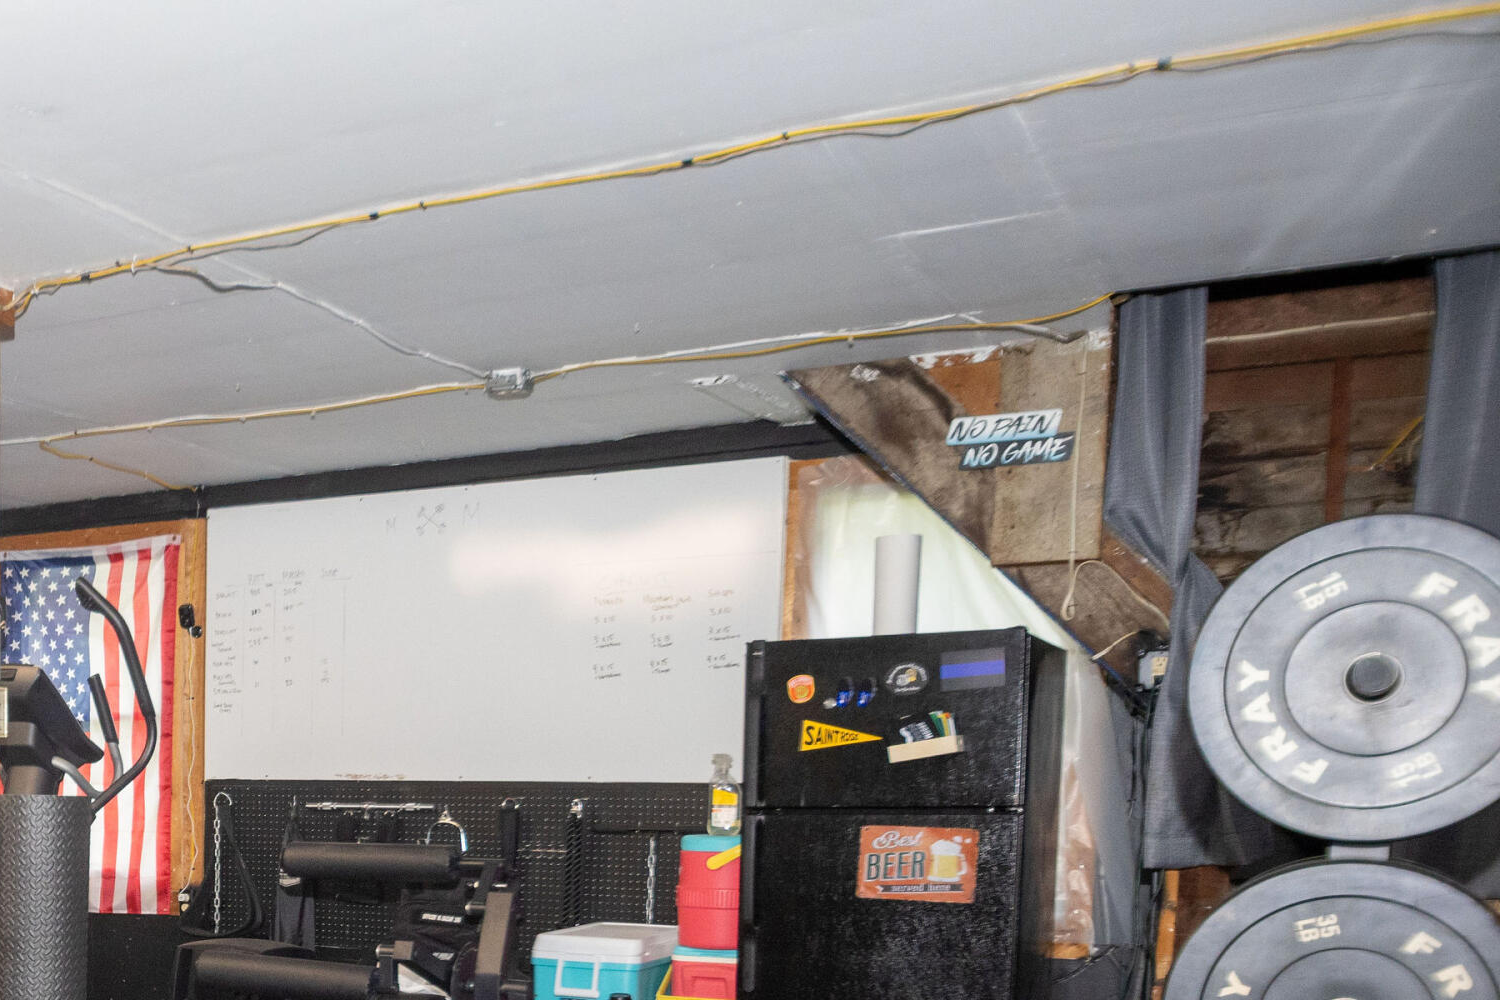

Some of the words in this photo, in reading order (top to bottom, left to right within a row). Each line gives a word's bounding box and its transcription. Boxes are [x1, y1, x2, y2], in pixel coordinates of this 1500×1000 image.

[951, 418, 987, 441] NO
[988, 412, 1057, 438] PAIN
[963, 443, 998, 467] NO
[1000, 436, 1073, 464] GAME
[1237, 660, 1330, 784] FRAY
[864, 851, 927, 882] BEER
